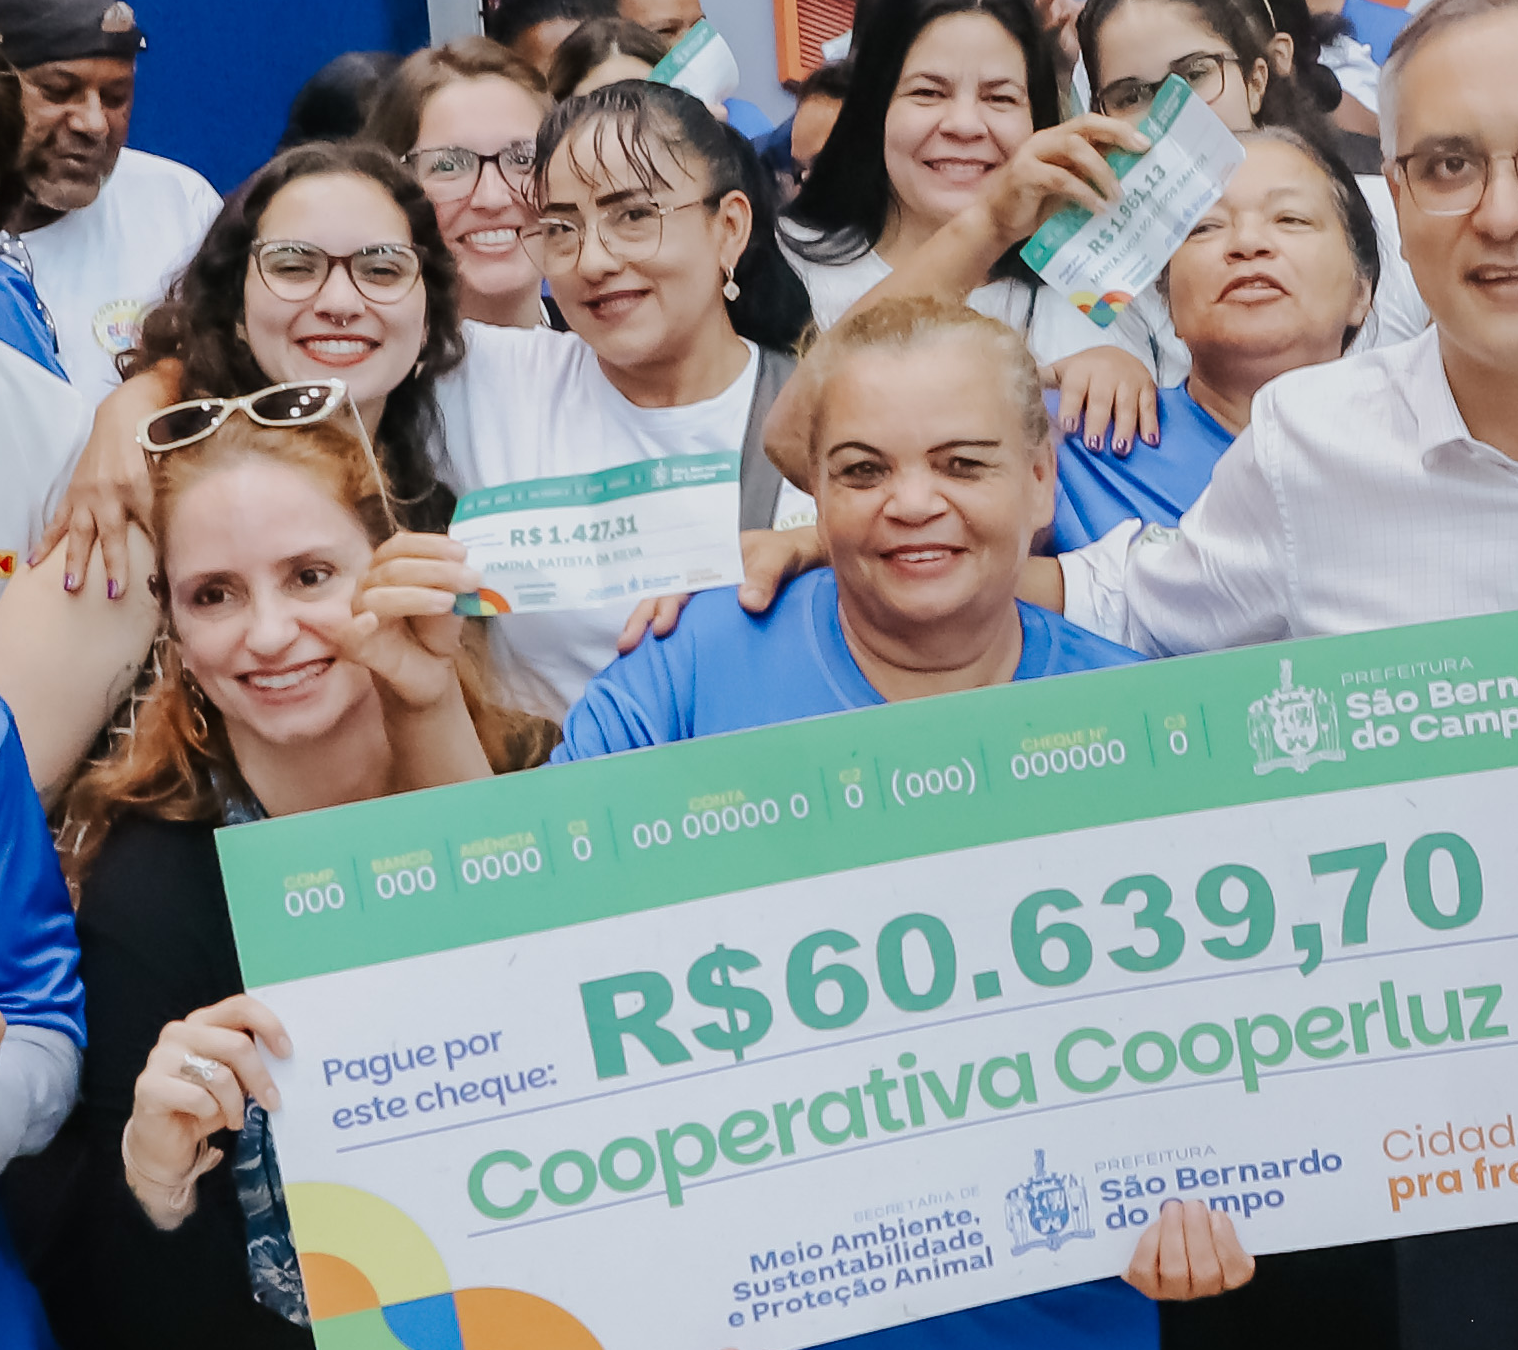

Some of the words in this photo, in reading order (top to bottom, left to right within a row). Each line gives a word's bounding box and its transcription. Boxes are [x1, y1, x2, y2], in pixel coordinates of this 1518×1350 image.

[510, 528, 543, 547] R$
[1341, 656, 1475, 687] PREFEITURA
[1347, 688, 1419, 721] São
[1021, 731, 1086, 752] CHEQUE
[1351, 718, 1401, 751] do
[285, 882, 345, 917] 000
[376, 865, 436, 899] 000
[462, 846, 542, 884] 0000
[892, 757, 975, 806] (000)
[1010, 739, 1126, 780] 000000
[579, 832, 1484, 1081] R$60.639,70
[322, 1044, 437, 1086] Pague
[443, 1031, 504, 1071] por
[332, 1095, 409, 1130] este
[415, 1061, 558, 1113] cheque:
[467, 1050, 1038, 1220] Cooperativa
[1054, 980, 1509, 1094] Cooperluz
[1094, 1144, 1217, 1174] PREFEITURA
[1100, 1171, 1166, 1202] São
[1175, 1149, 1343, 1192] Bernardo
[854, 1190, 955, 1223] SECRETARIA
[960, 1185, 980, 1200] DE
[1387, 1166, 1462, 1213] pra
[1105, 1200, 1148, 1231] do
[733, 1229, 984, 1301] Sustentabilidade
[750, 1240, 823, 1274] Meio
[832, 1208, 981, 1255] Ambiente,
[728, 1311, 744, 1328] e
[752, 1277, 887, 1323] Proteção
[895, 1246, 994, 1289] Animal
